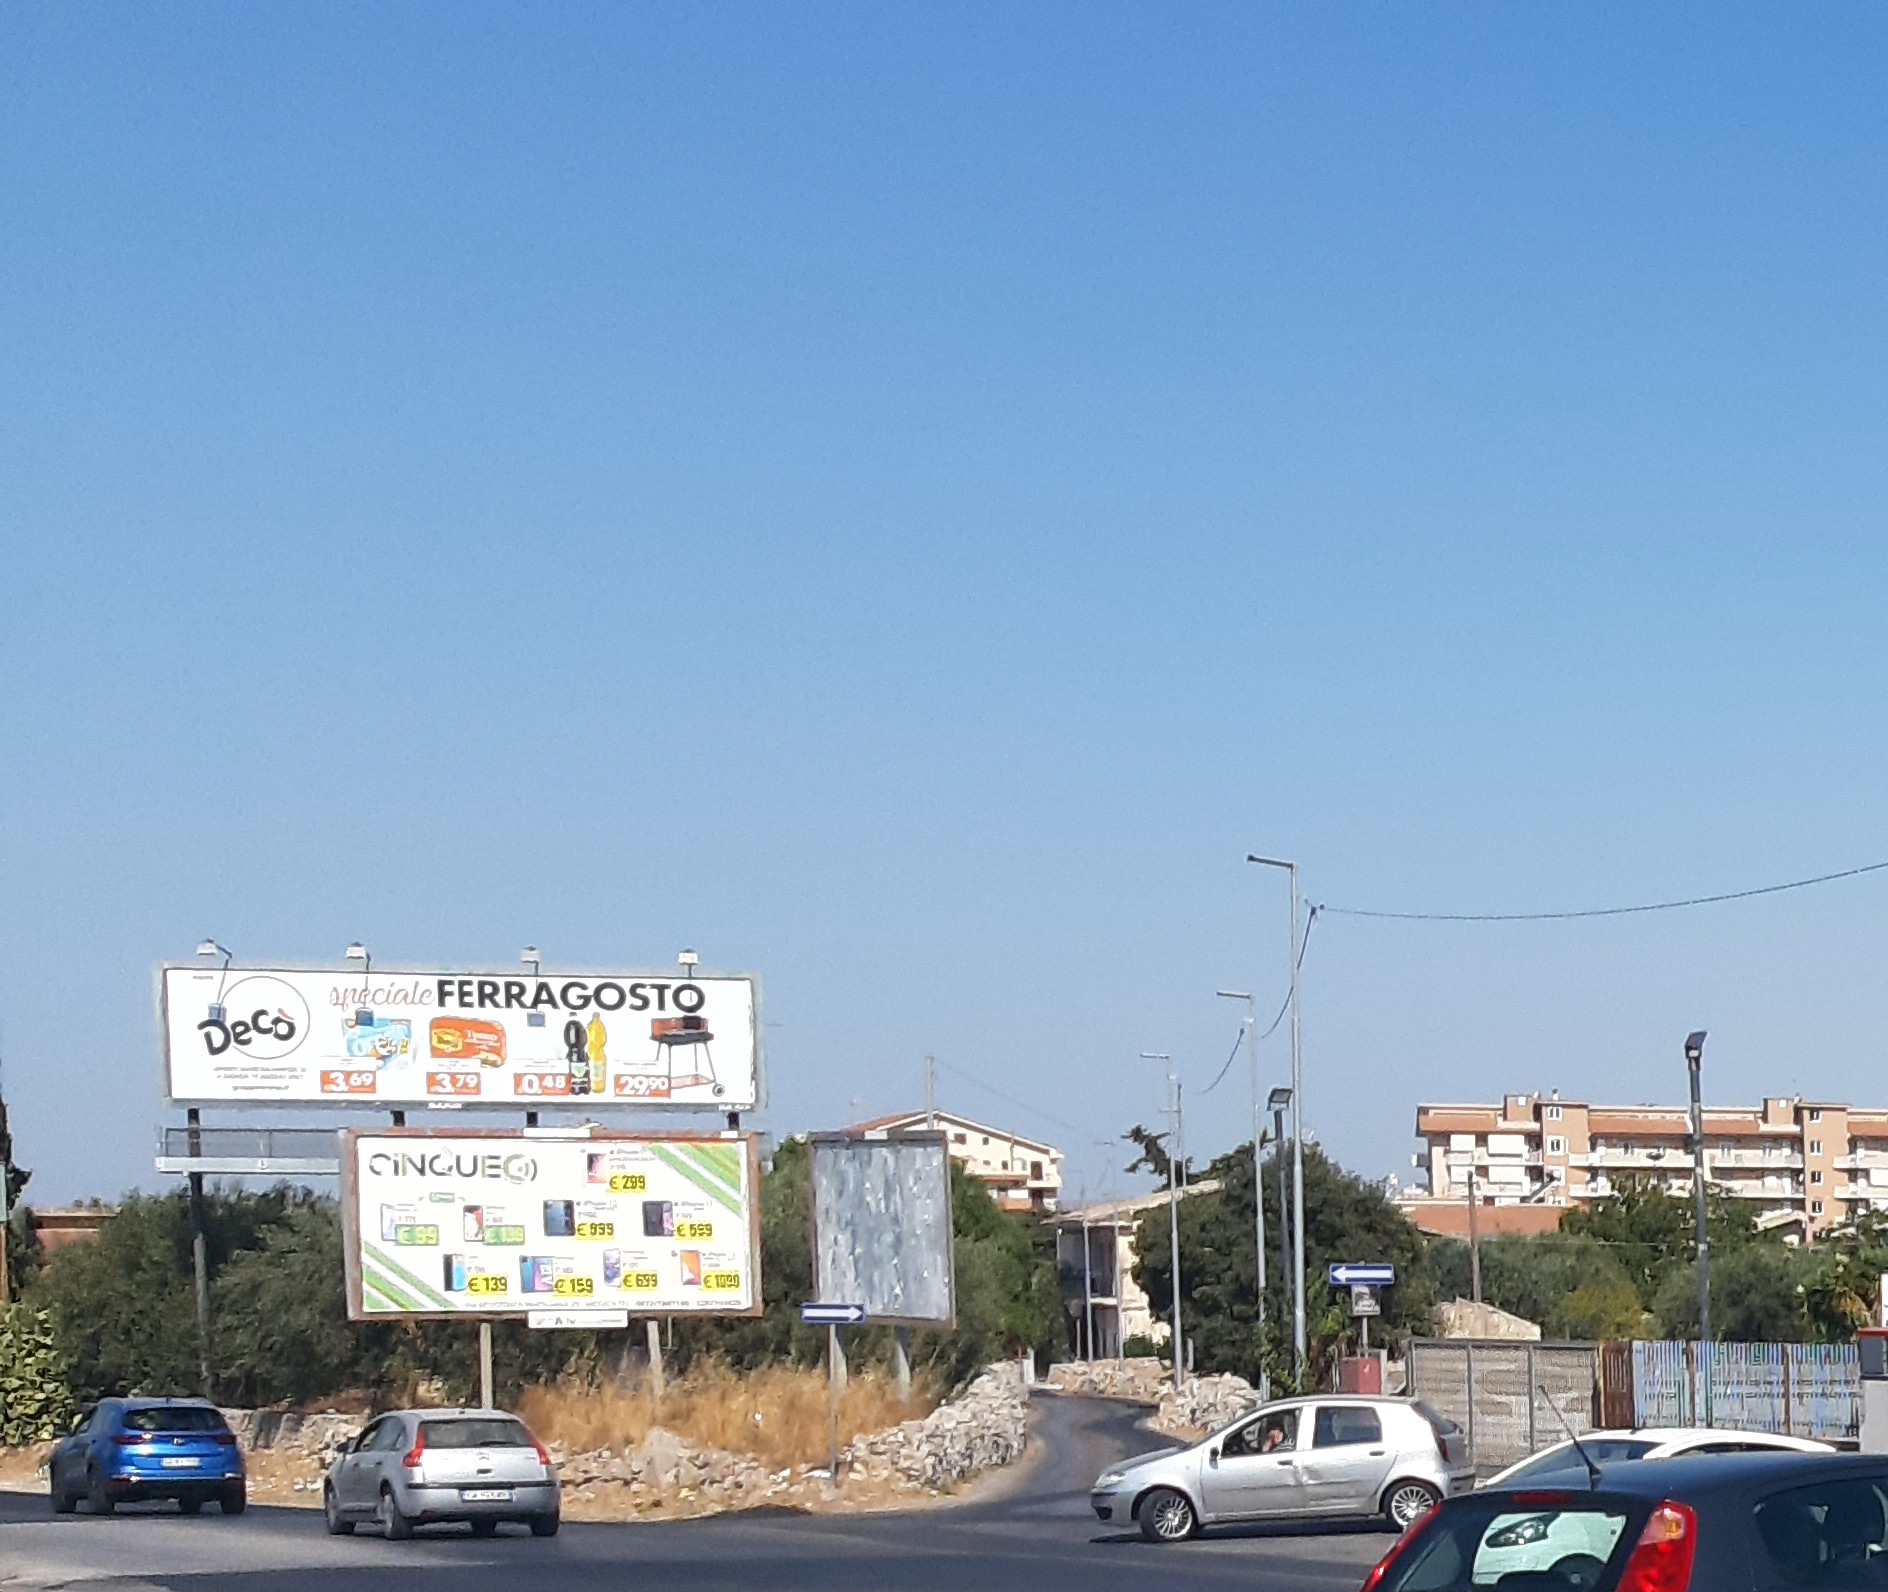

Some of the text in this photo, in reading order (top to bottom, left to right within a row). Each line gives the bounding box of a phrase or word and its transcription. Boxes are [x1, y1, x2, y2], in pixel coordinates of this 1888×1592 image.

[329, 978, 706, 1014] speciale FERRAGOSTO
[484, 1276, 508, 1292] 139
[570, 1278, 594, 1294] 159
